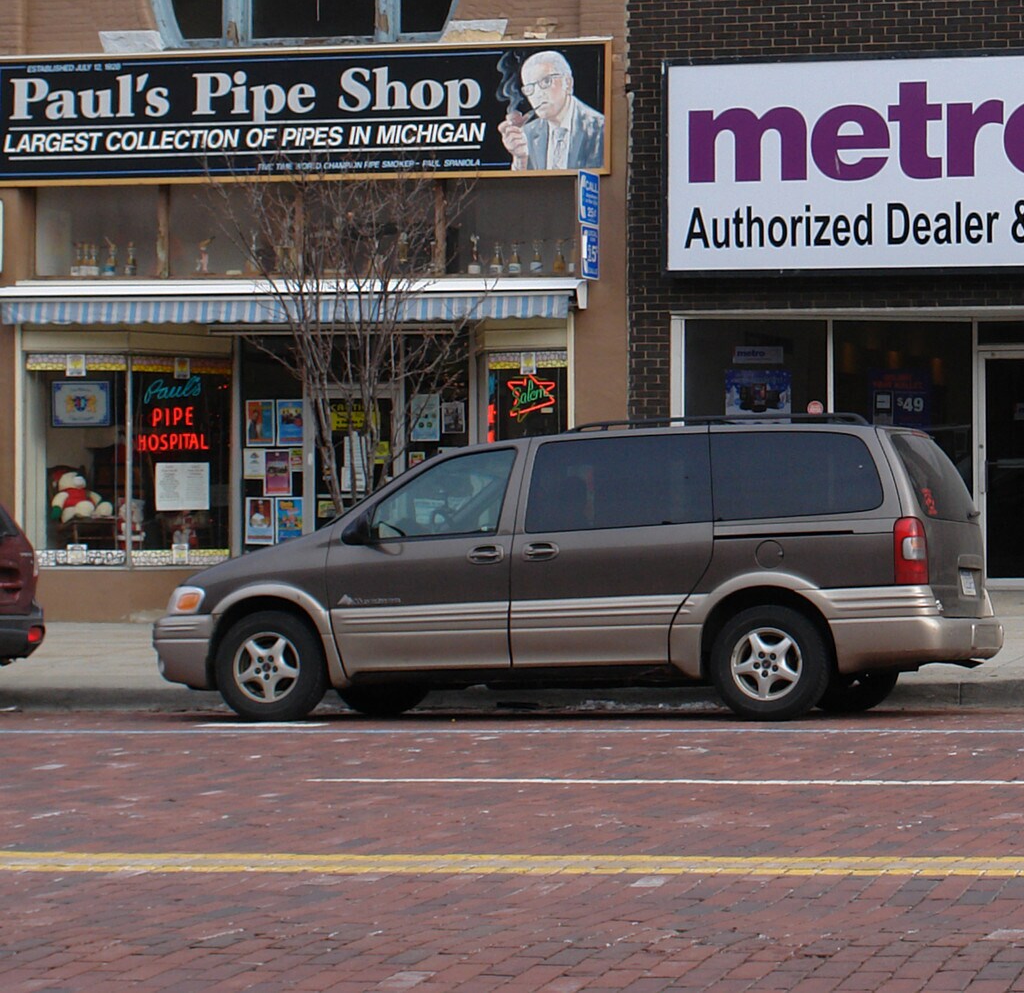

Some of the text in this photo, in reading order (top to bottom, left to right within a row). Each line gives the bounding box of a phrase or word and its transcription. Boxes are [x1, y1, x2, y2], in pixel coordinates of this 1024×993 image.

[9, 66, 481, 122] Paul's Pipe Shop
[4, 132, 103, 153] LARGEST
[105, 129, 240, 151] COLLECTION
[246, 128, 277, 148] OF
[349, 125, 371, 145] IN
[376, 122, 486, 144] MICHIGAN
[685, 204, 873, 249] Authorized
[887, 201, 999, 245] Dealer
[144, 375, 201, 404] Paul's
[152, 407, 194, 427] PIPE
[896, 397, 924, 412] $49
[137, 433, 209, 451] HOSPITAL
